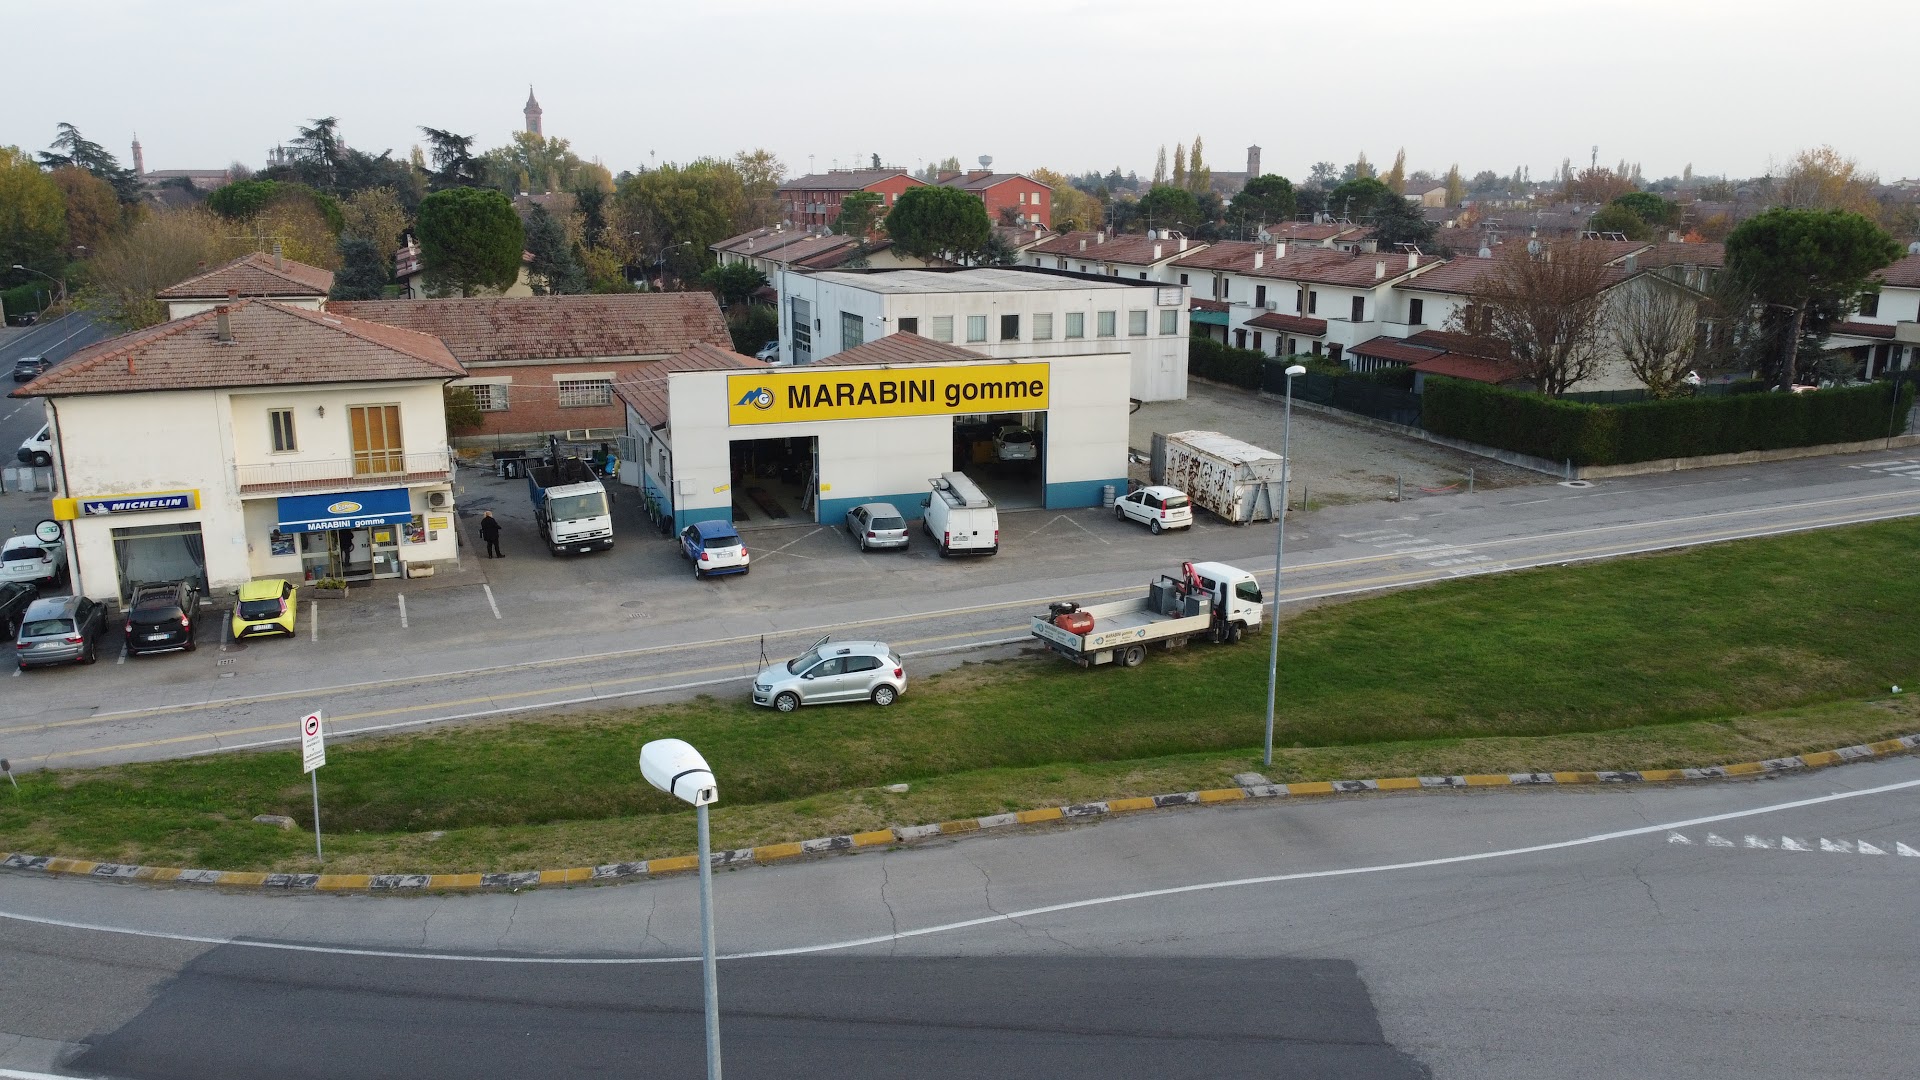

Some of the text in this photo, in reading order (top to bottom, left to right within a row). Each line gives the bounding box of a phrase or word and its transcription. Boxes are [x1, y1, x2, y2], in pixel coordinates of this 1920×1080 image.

[788, 379, 1044, 409] MARABINI gomme
[111, 499, 181, 511] MICHELIN
[307, 518, 384, 531] MARABINI gomme
